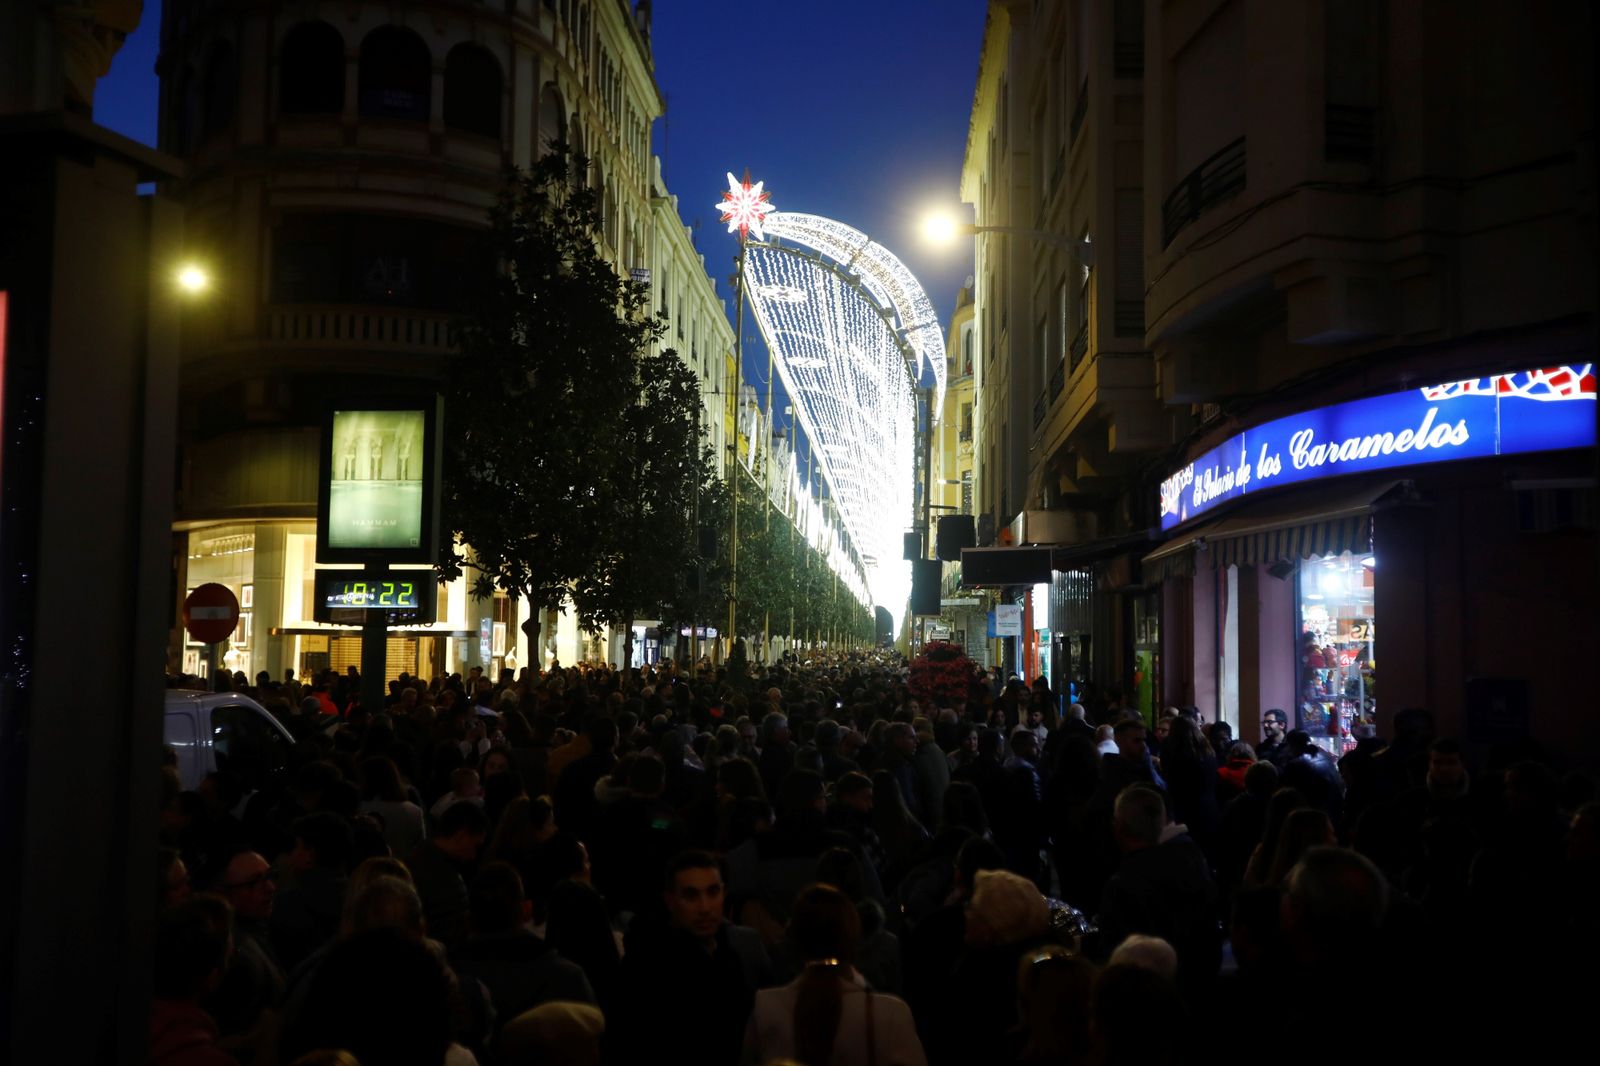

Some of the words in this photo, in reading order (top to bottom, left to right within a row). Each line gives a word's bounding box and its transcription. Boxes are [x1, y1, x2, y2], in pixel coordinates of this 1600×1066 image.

[1193, 475, 1203, 507] El
[1203, 465, 1235, 503] Palacio
[1236, 450, 1251, 487] de
[1257, 443, 1281, 479] los
[1289, 407, 1470, 470] Caramelos
[352, 519, 397, 527] HAMMAM
